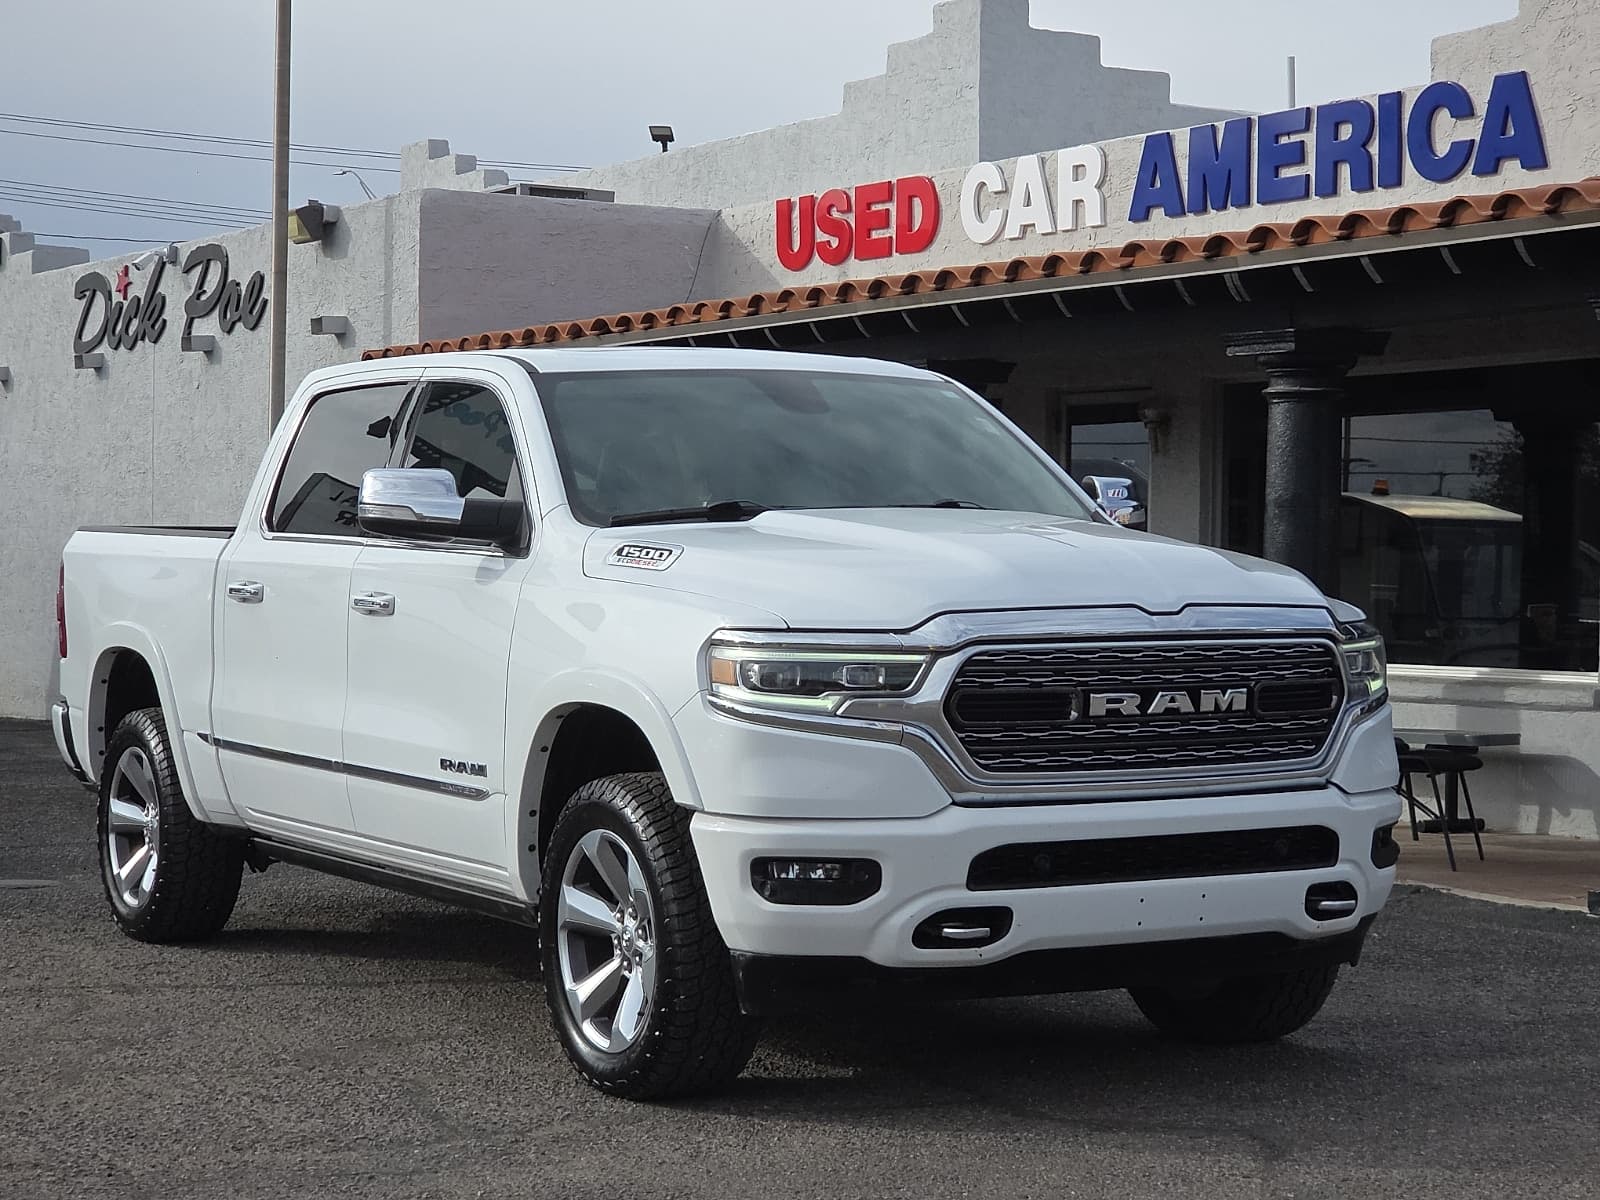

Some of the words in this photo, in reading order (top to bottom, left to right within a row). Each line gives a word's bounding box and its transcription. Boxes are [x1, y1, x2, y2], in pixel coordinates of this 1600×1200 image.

[775, 175, 941, 272] USED
[960, 143, 1107, 245] CAR
[1127, 70, 1549, 223] AMERICA
[73, 255, 167, 354] Dick
[182, 243, 268, 337] Poe
[621, 546, 671, 560] 1500
[1089, 688, 1248, 716] RAM
[440, 758, 488, 777] RAM
